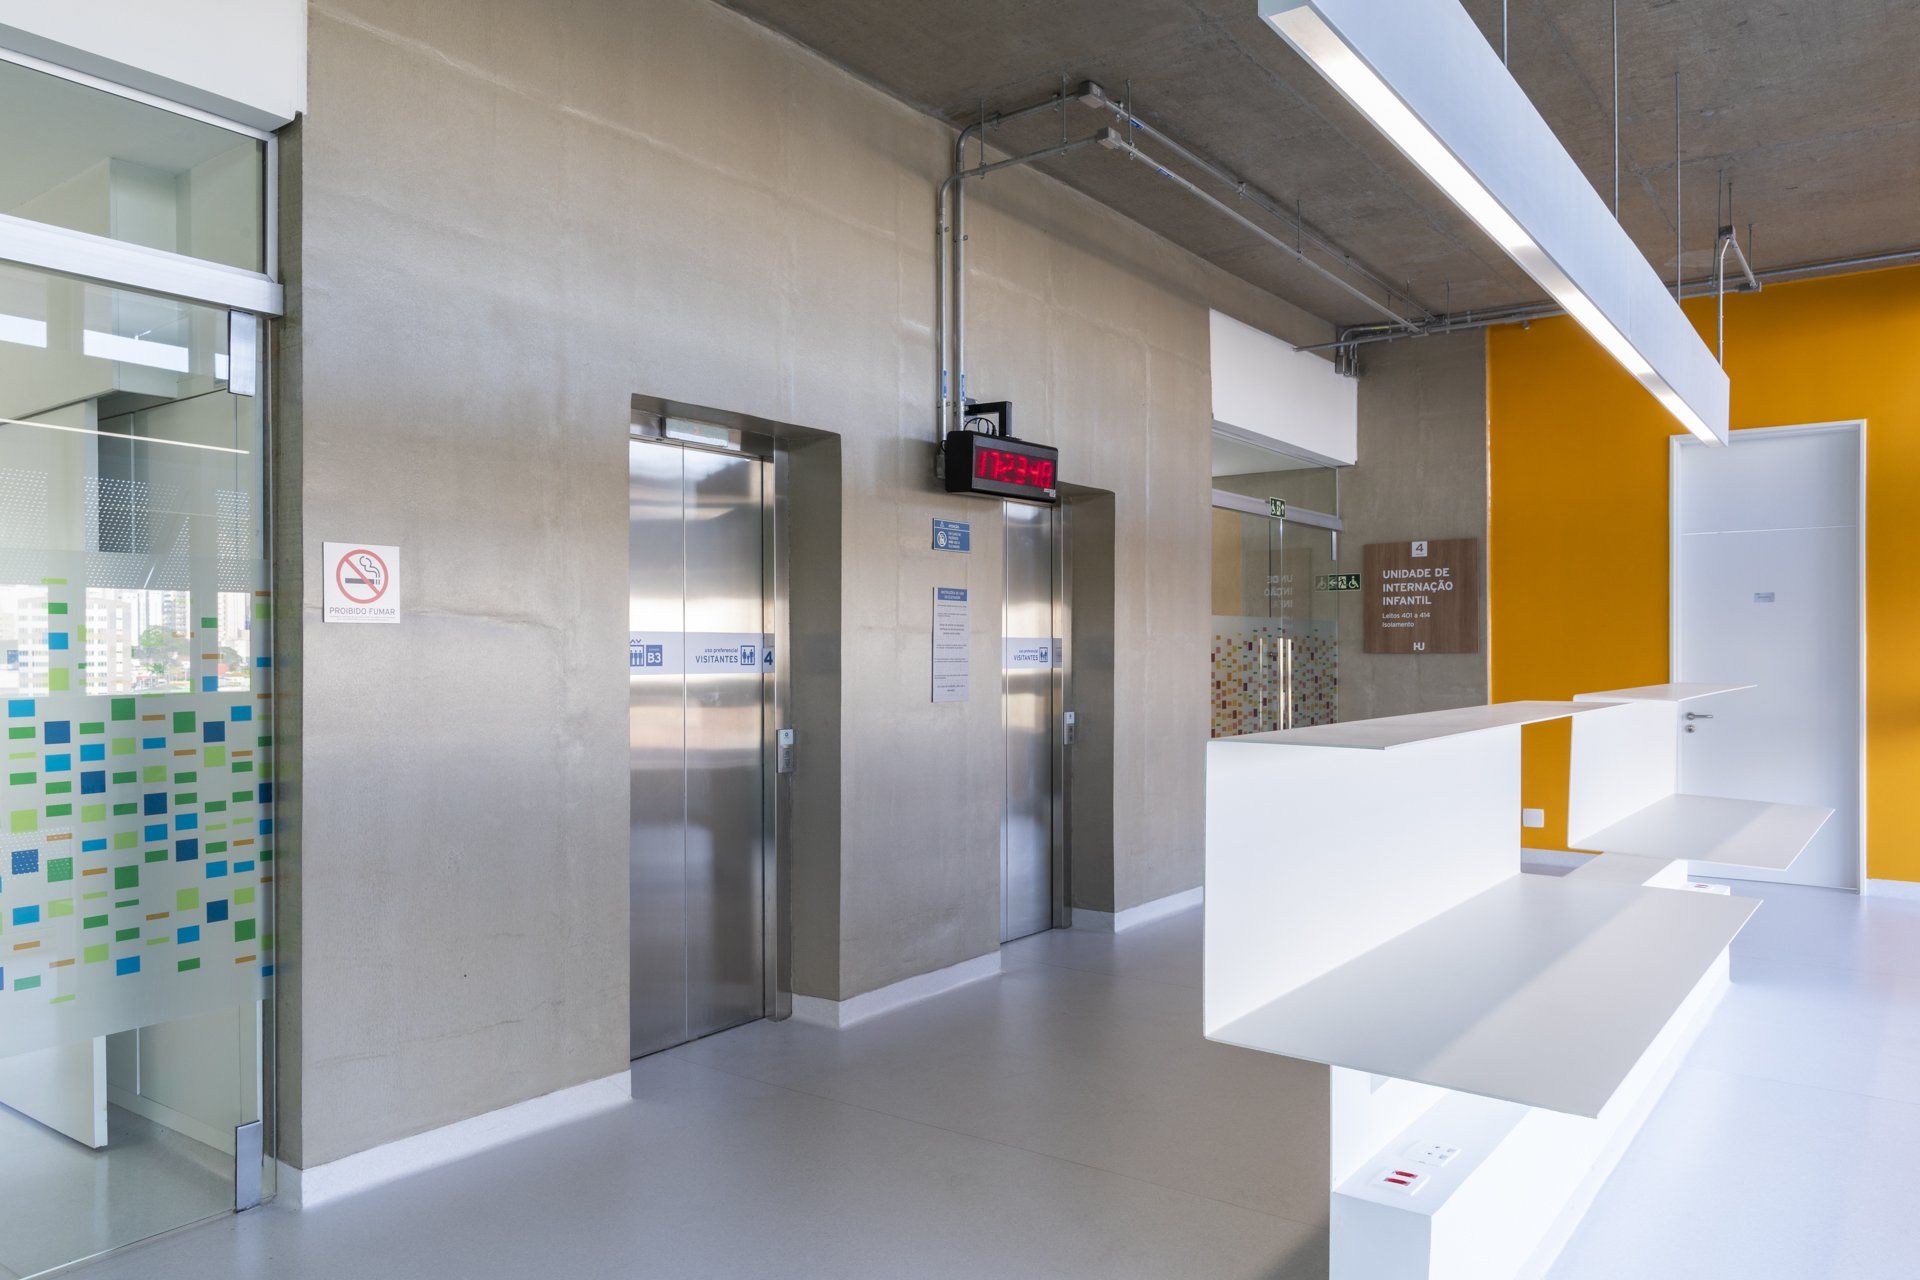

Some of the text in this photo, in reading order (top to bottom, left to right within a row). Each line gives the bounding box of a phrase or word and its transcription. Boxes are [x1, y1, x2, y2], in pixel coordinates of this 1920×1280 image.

[1415, 543, 1424, 553] 4
[1383, 567, 1450, 579] UNIDADE DE
[1382, 580, 1454, 593] INTERNAÇÃO
[1382, 596, 1432, 606] INFANTIL
[329, 606, 367, 615] PROIBIDO
[647, 652, 661, 664] B3
[695, 655, 739, 664] VISITANTES
[764, 651, 773, 666] 4
